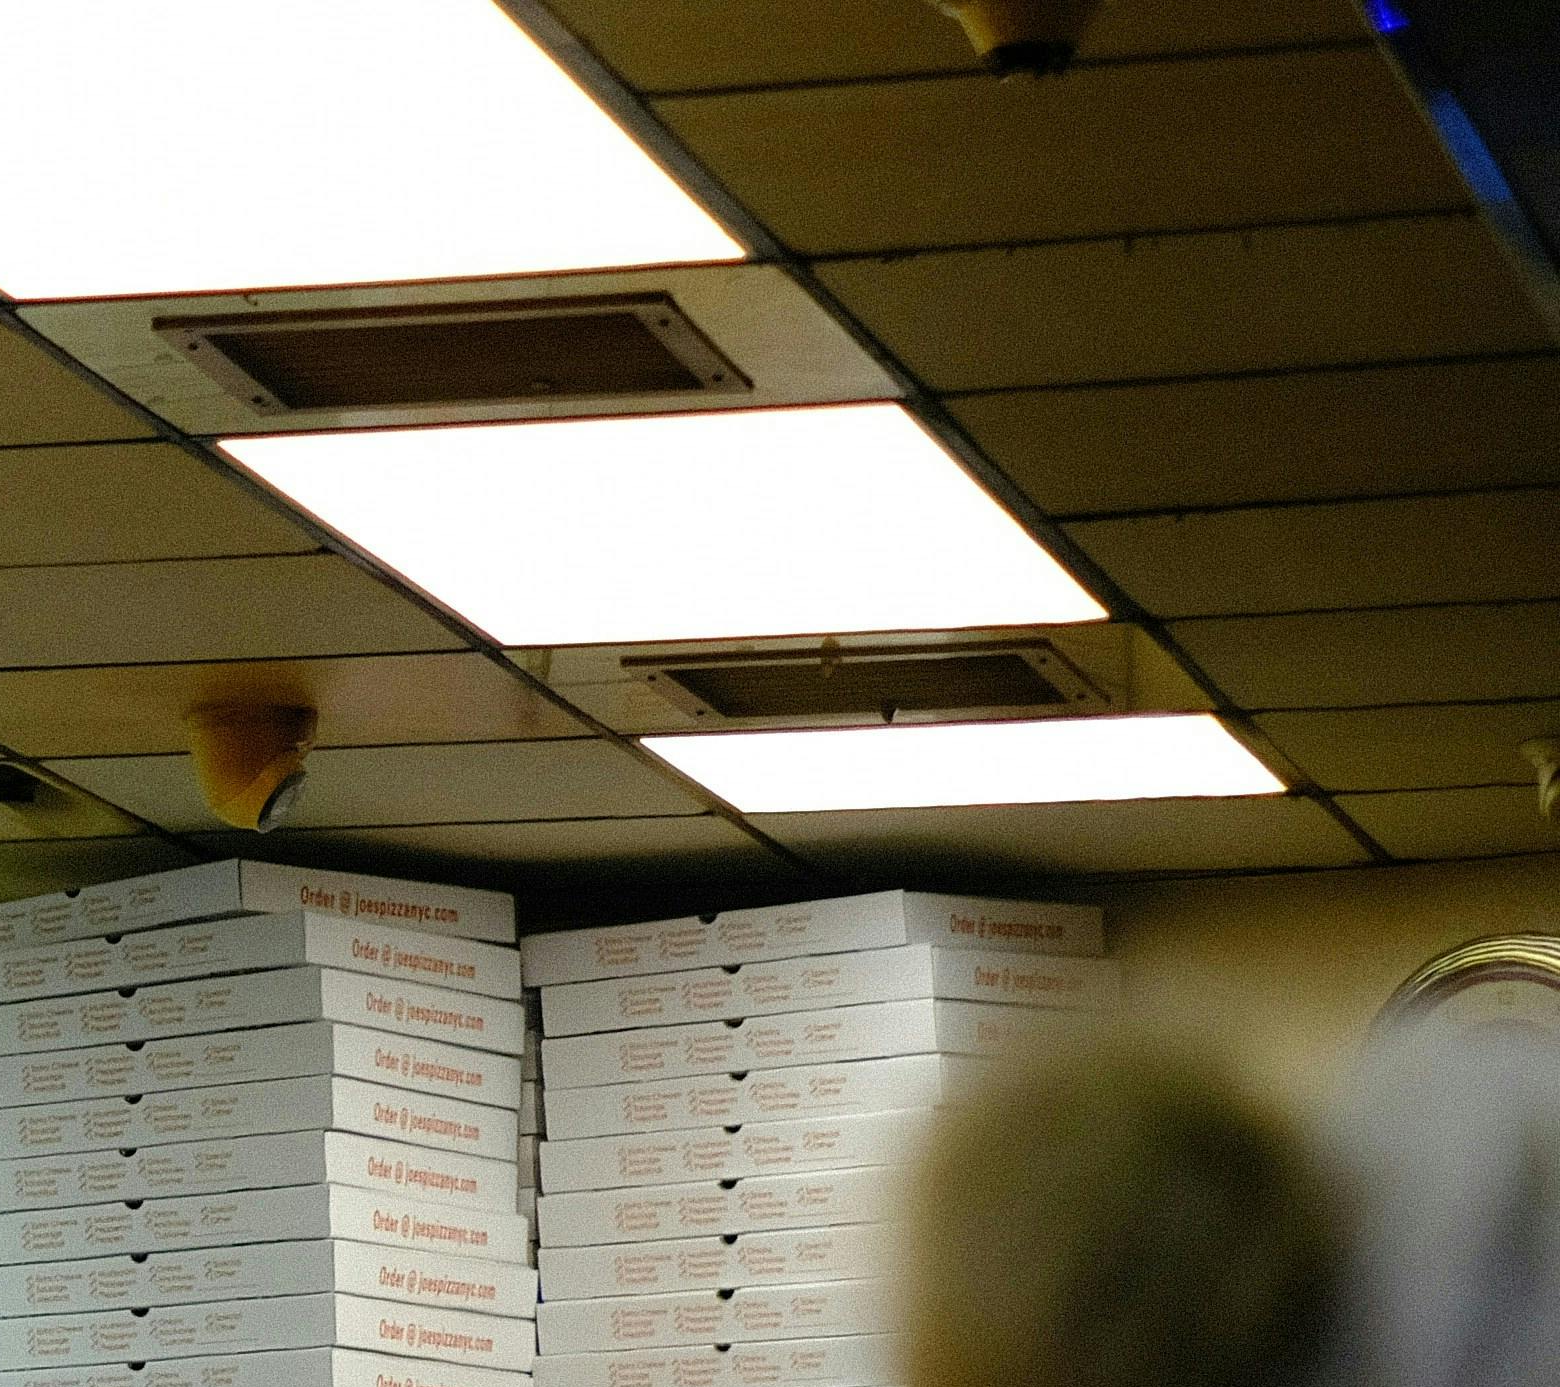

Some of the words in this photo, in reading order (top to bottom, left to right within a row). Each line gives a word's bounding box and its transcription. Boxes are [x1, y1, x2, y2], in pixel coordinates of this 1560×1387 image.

[300, 886, 334, 908] Order
[340, 893, 352, 915] @
[355, 892, 458, 922] joespizzanyc.com
[352, 938, 378, 959] Order
[382, 945, 391, 965] @
[393, 946, 476, 979] joespizzanyc.com
[366, 992, 392, 1014] Order
[395, 998, 404, 1020] @
[406, 1000, 484, 1031] joespizzanyc.com
[374, 1048, 399, 1070] Order
[401, 1053, 410, 1076] @
[411, 1054, 482, 1087] joespizzanyc.com
[373, 1102, 397, 1124] Order
[400, 1107, 408, 1130] @
[409, 1108, 480, 1140] joespizzanyc.com
[368, 1157, 392, 1178] Order
[395, 1162, 404, 1185] @
[405, 1162, 478, 1194] joespizzanyc.com
[373, 1210, 398, 1231] Order
[401, 1214, 410, 1238] @
[411, 1216, 488, 1245] joespizzanyc.com
[379, 1266, 404, 1288] Order
[407, 1270, 416, 1293] @
[418, 1271, 496, 1299] joespizzanyc.com
[379, 1320, 404, 1341] Order
[407, 1324, 416, 1347] @
[418, 1324, 493, 1353] joespizzanyc.com
